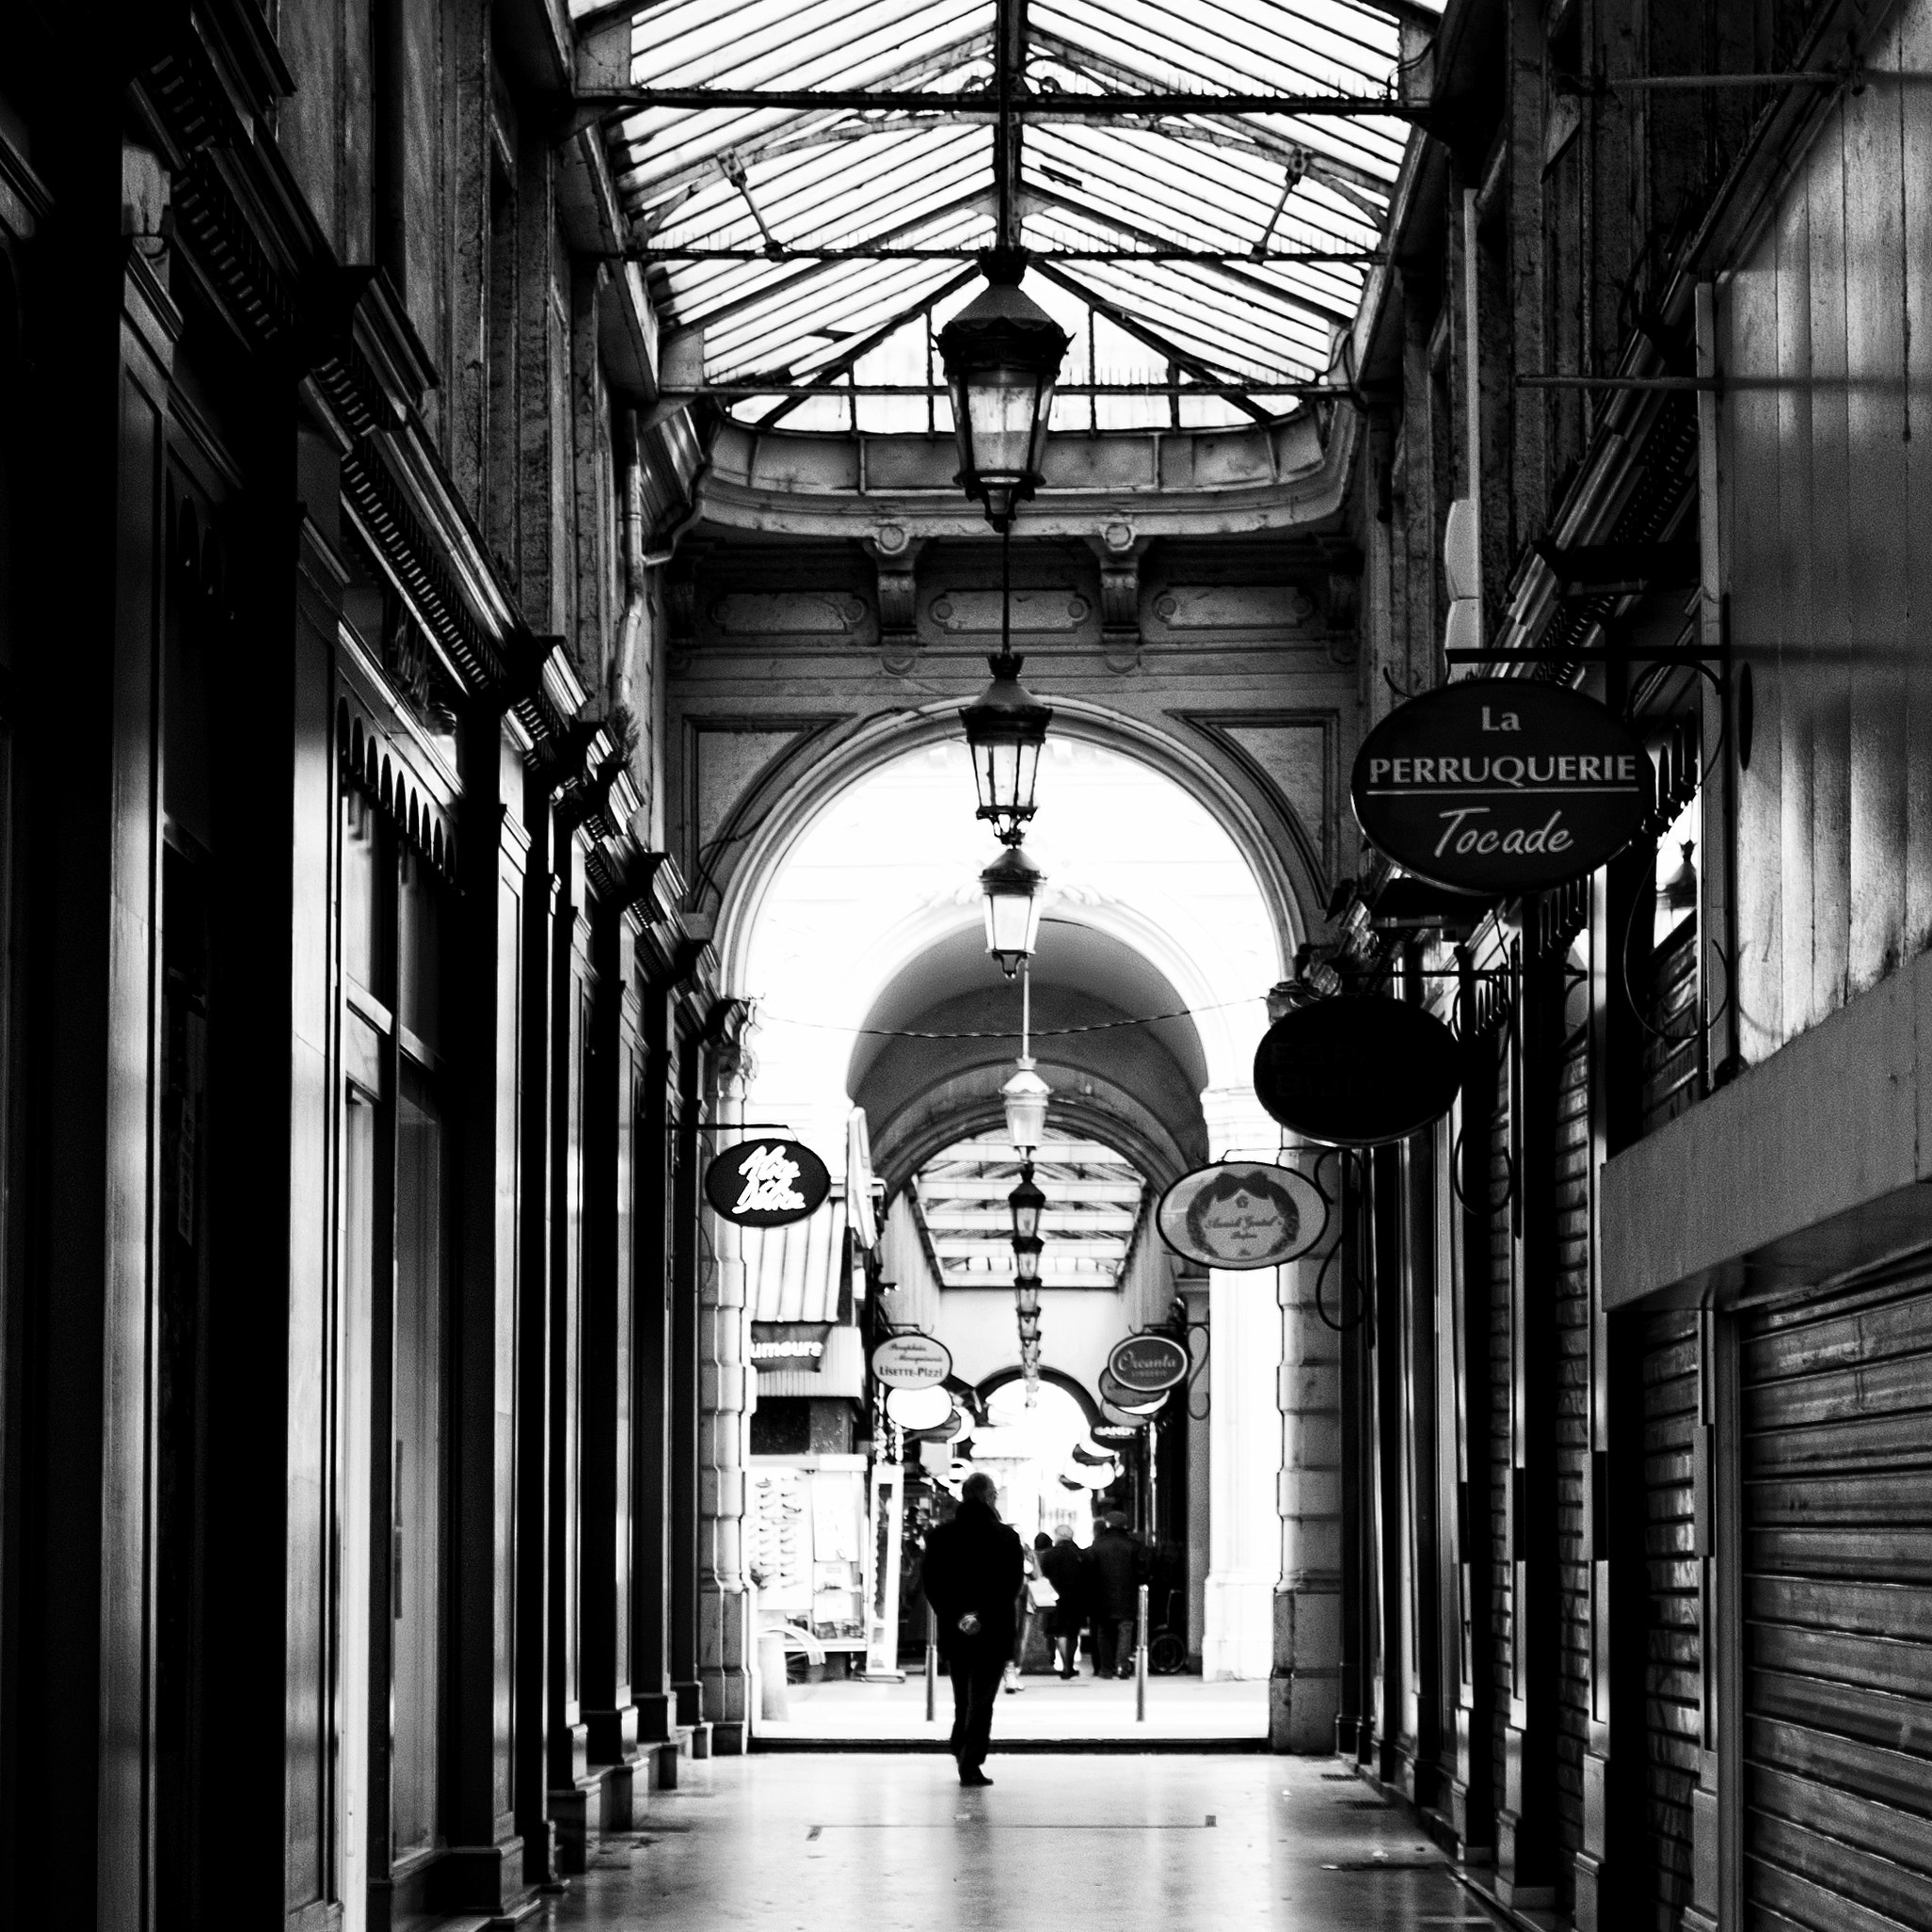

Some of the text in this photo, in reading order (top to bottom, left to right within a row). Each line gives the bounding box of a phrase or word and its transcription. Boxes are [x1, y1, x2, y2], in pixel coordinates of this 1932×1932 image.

[1481, 706, 1522, 732] La
[1369, 756, 1637, 789] PERRUQUERIE
[1433, 807, 1575, 859] Tocade
[749, 1341, 824, 1358] umeurs
